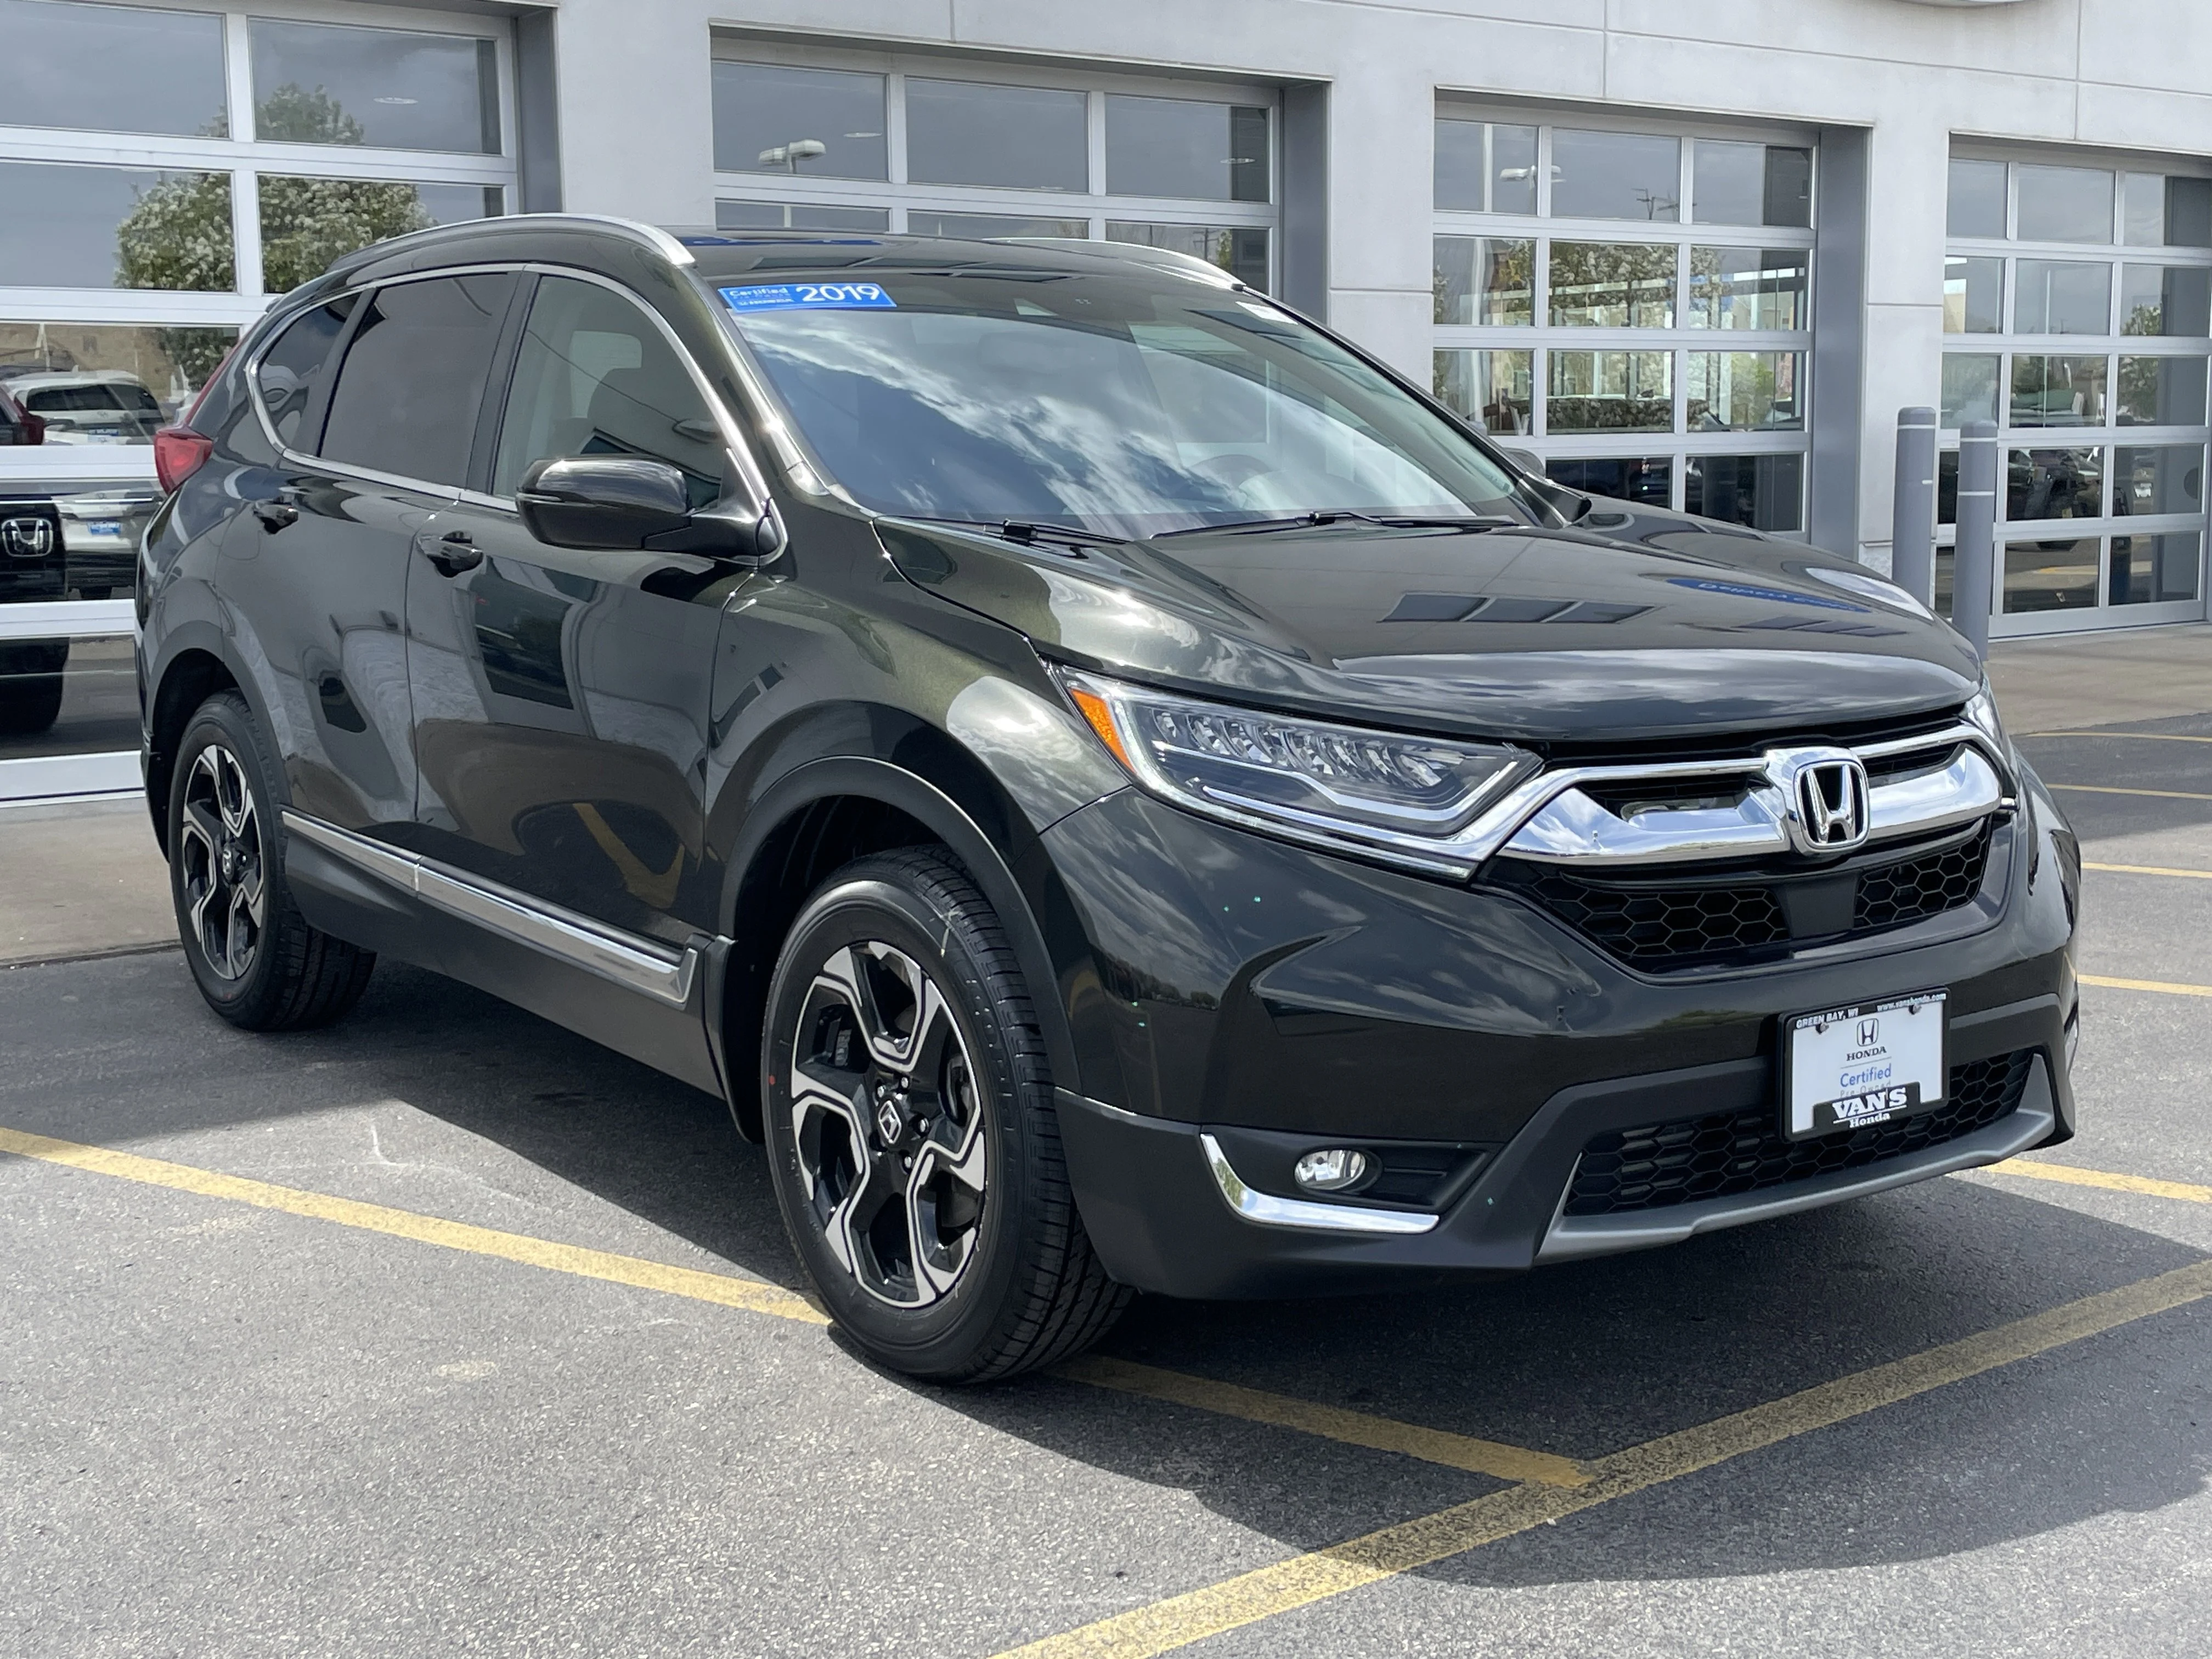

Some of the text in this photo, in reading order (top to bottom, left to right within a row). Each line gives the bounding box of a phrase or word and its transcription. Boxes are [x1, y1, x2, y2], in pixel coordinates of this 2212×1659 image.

[729, 286, 788, 296] Certified
[795, 285, 880, 302] 2019
[1796, 1014, 1825, 1029] GREEN
[1846, 1046, 1887, 1062] HONDA
[1840, 1062, 1892, 1087] Certified
[1849, 1113, 1891, 1128] Honda
